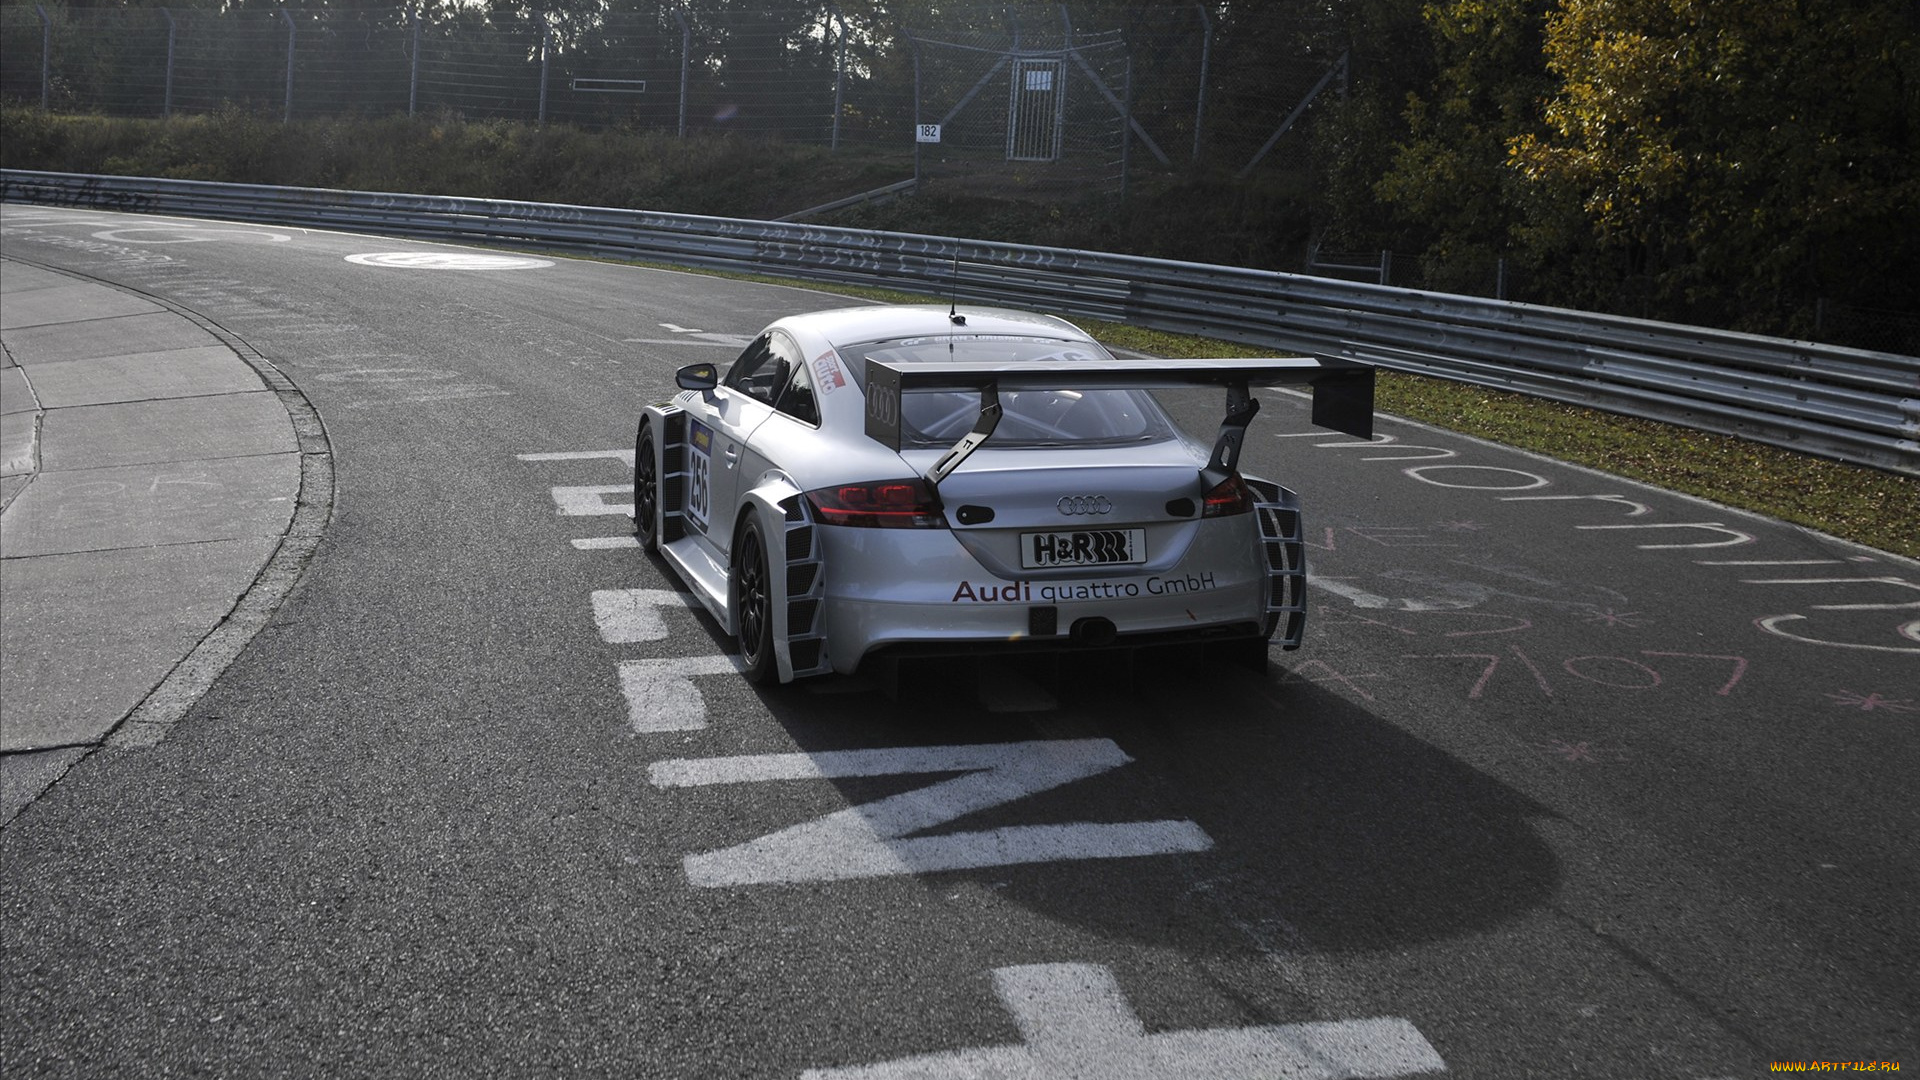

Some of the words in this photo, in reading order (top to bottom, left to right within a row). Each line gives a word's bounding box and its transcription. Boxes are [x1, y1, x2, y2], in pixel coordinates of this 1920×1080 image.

[920, 125, 937, 137] 182
[691, 452, 708, 517] 256
[952, 580, 1031, 602] Audi
[1040, 581, 1140, 604] quattro
[1146, 572, 1216, 595] GmbH
